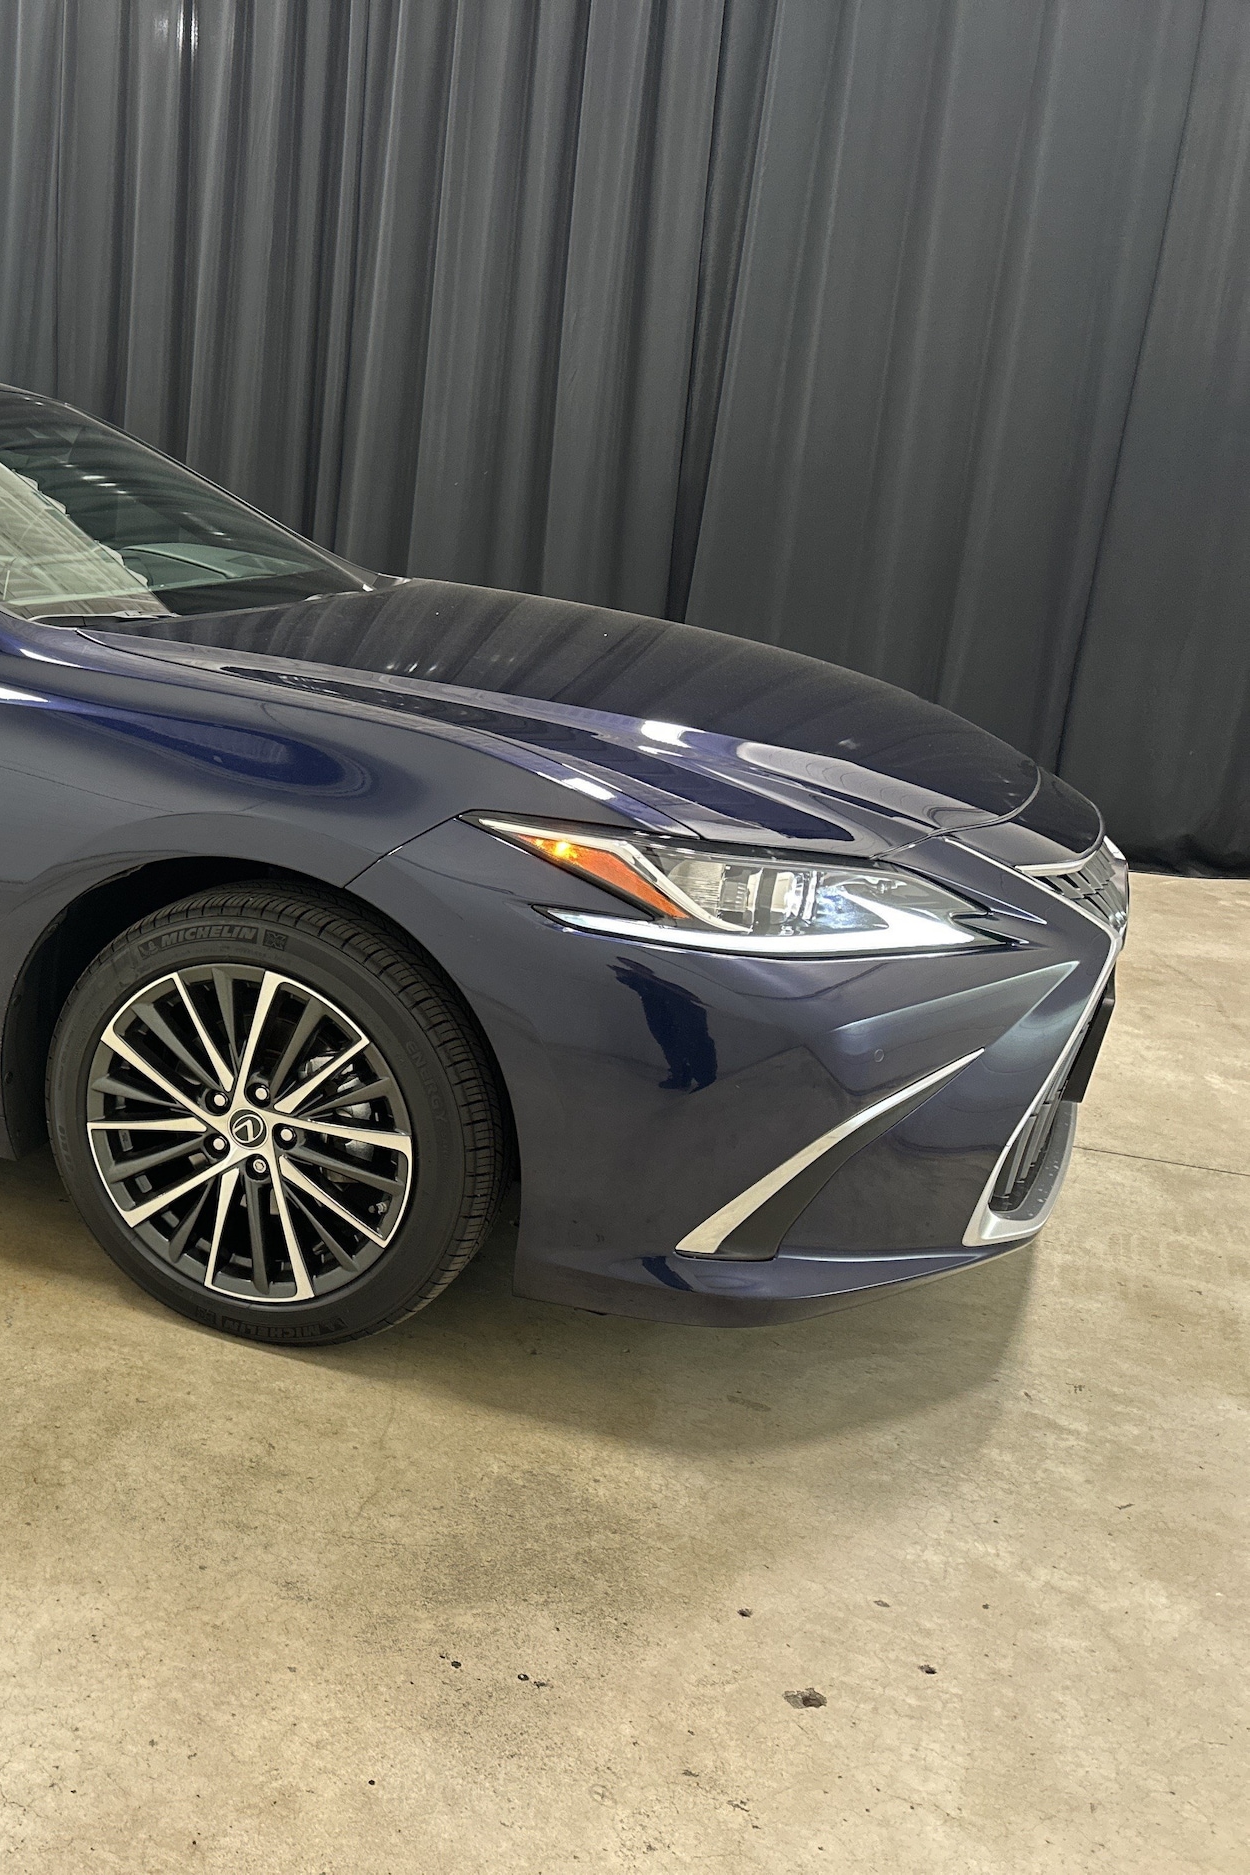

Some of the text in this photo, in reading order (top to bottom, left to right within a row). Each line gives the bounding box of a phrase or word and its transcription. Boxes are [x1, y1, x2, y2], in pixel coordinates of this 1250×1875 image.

[161, 925, 256, 947] MICHELIN
[406, 1040, 448, 1123] ENERGY
[224, 1320, 321, 1338] MICHELIN
